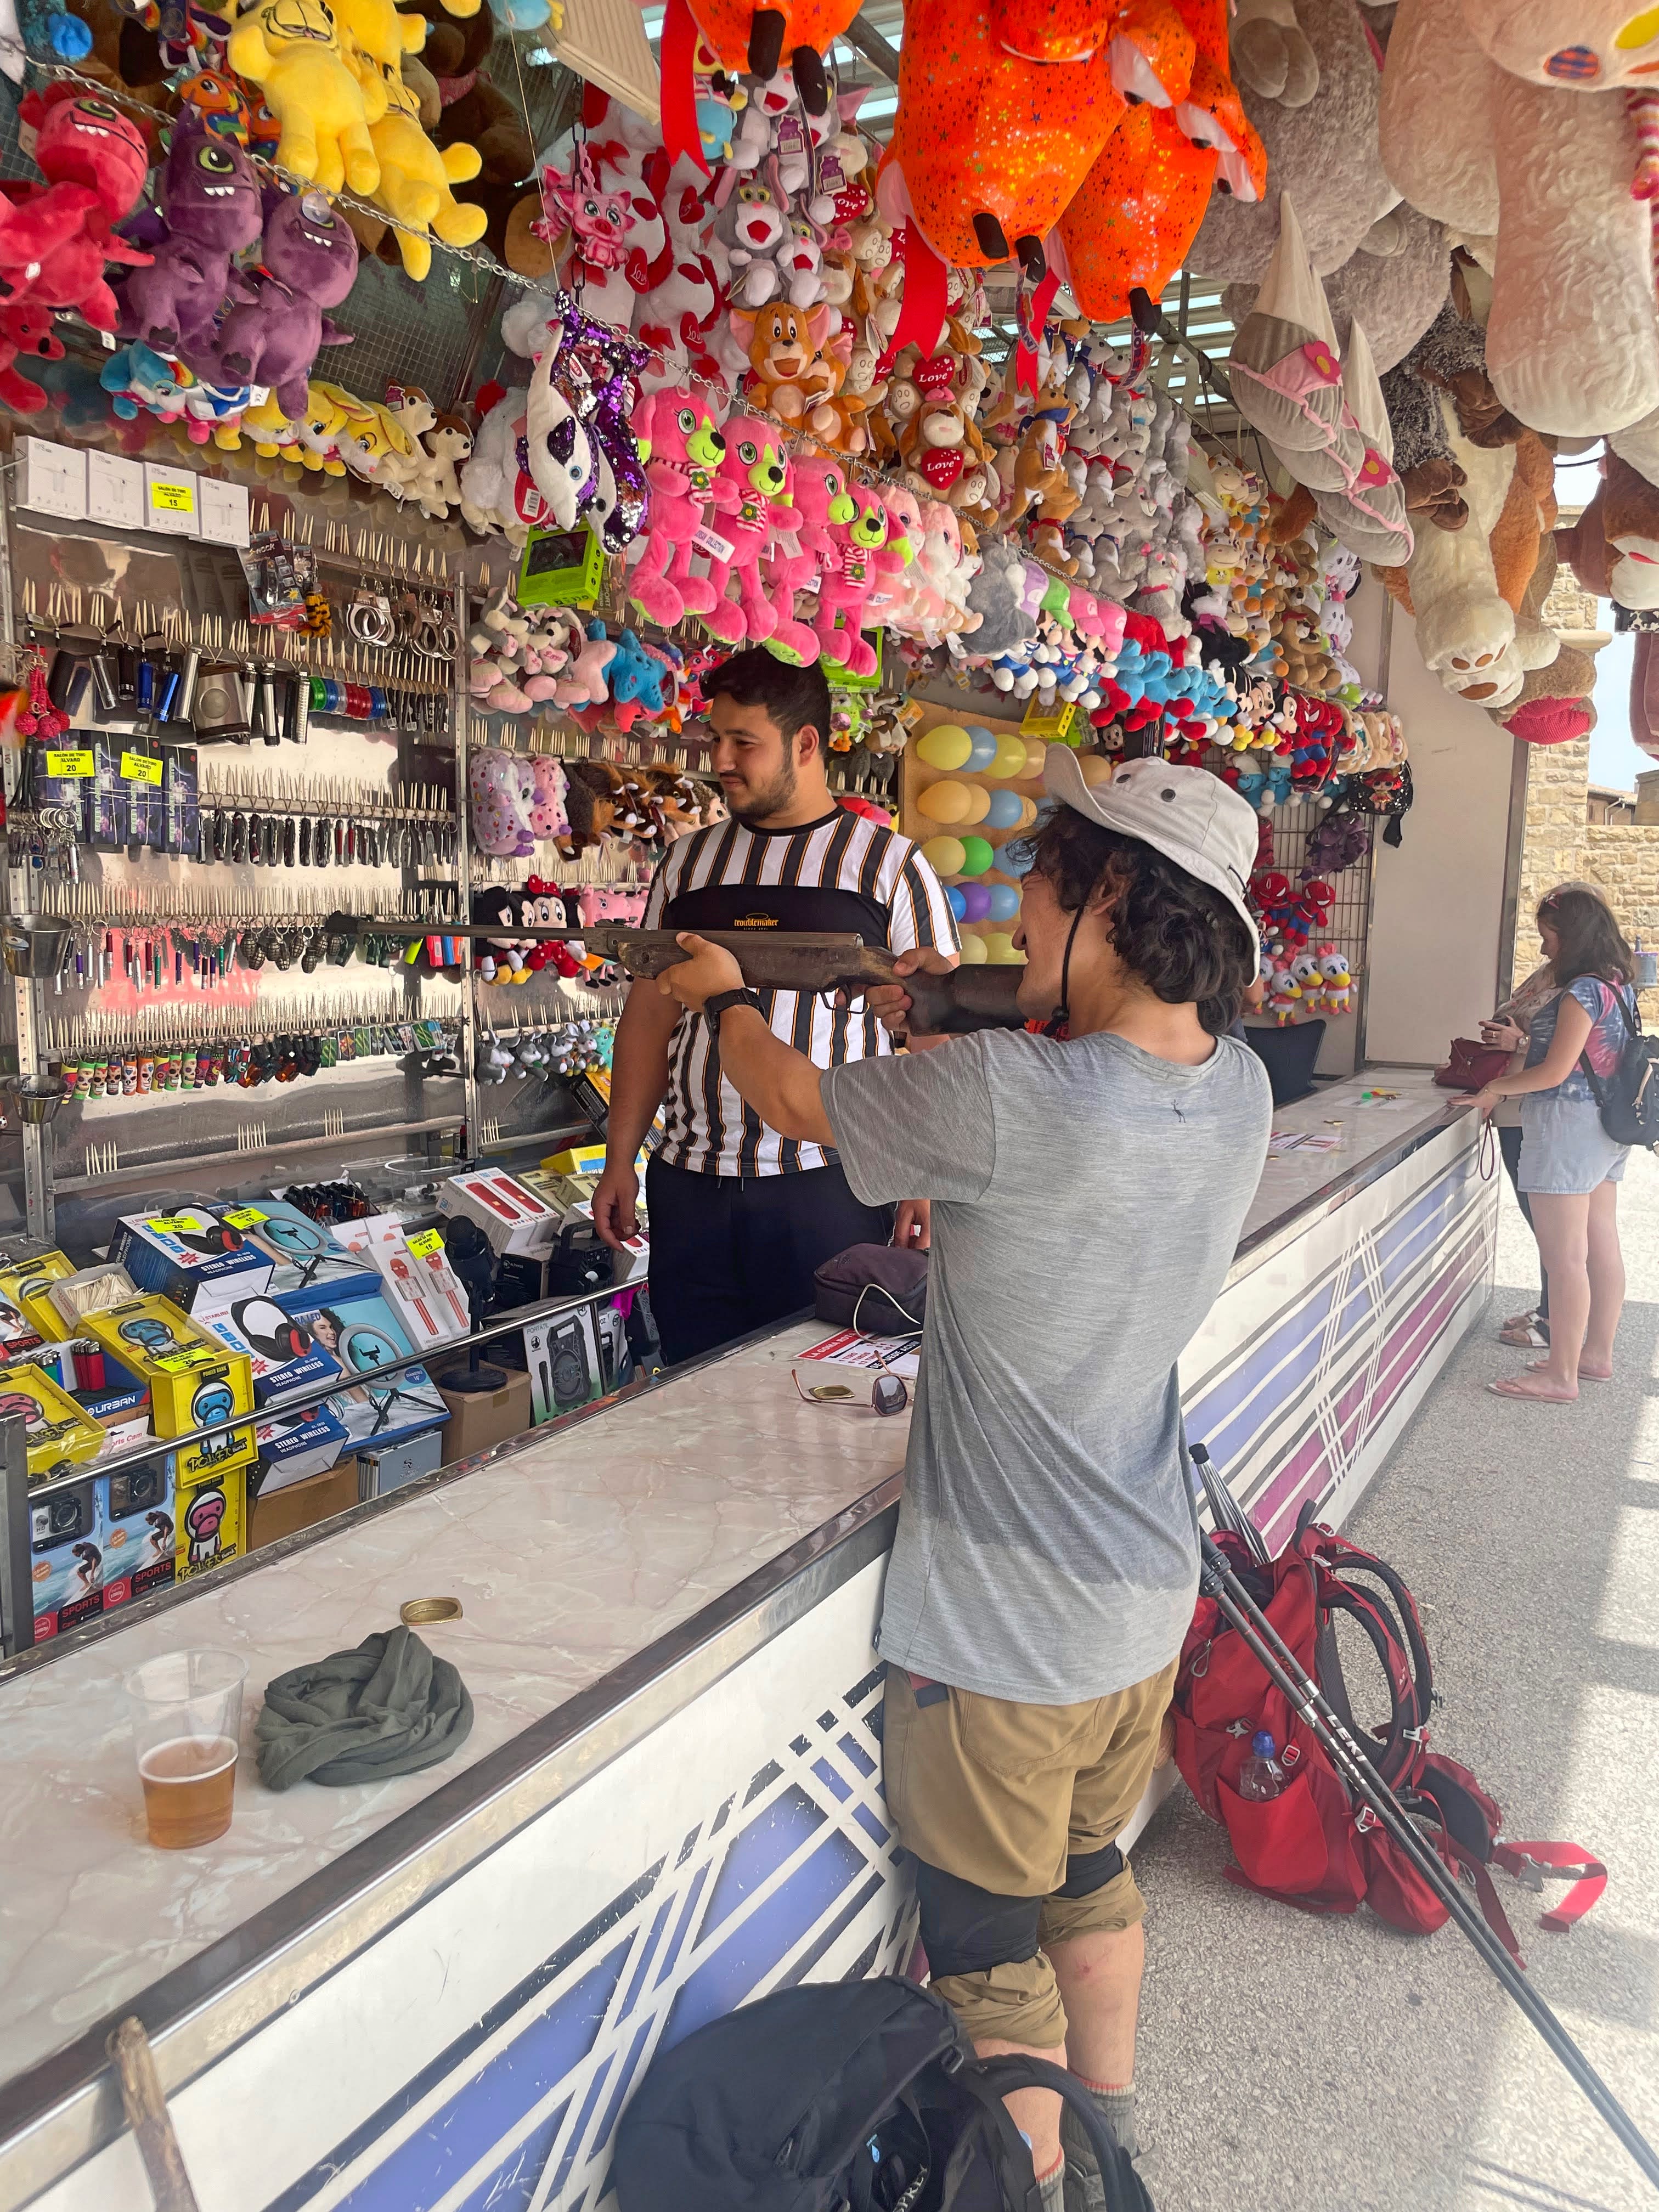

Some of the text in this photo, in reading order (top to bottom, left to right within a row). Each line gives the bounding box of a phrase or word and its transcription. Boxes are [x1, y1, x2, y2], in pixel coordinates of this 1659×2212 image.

[836, 197, 859, 210] ove
[918, 372, 948, 383] Love
[927, 460, 955, 472] Love
[734, 918, 778, 927] troublemaker
[200, 1254, 257, 1272] STEREO WIRELESS
[6, 1337, 41, 1349] SPORTS
[269, 1360, 324, 1384] STEREO WIRELESS
[275, 1376, 302, 1387] HEADPHONE
[95, 1395, 136, 1414] URBAN
[127, 1431, 143, 1443] Cam
[274, 1426, 331, 1449] STEREO WIRELESS
[279, 1441, 307, 1453] HEADPHONE
[135, 1561, 172, 1583] SPORTS
[62, 1595, 100, 1618] SPORTS
[1327, 1714, 1367, 1762] LEKI
